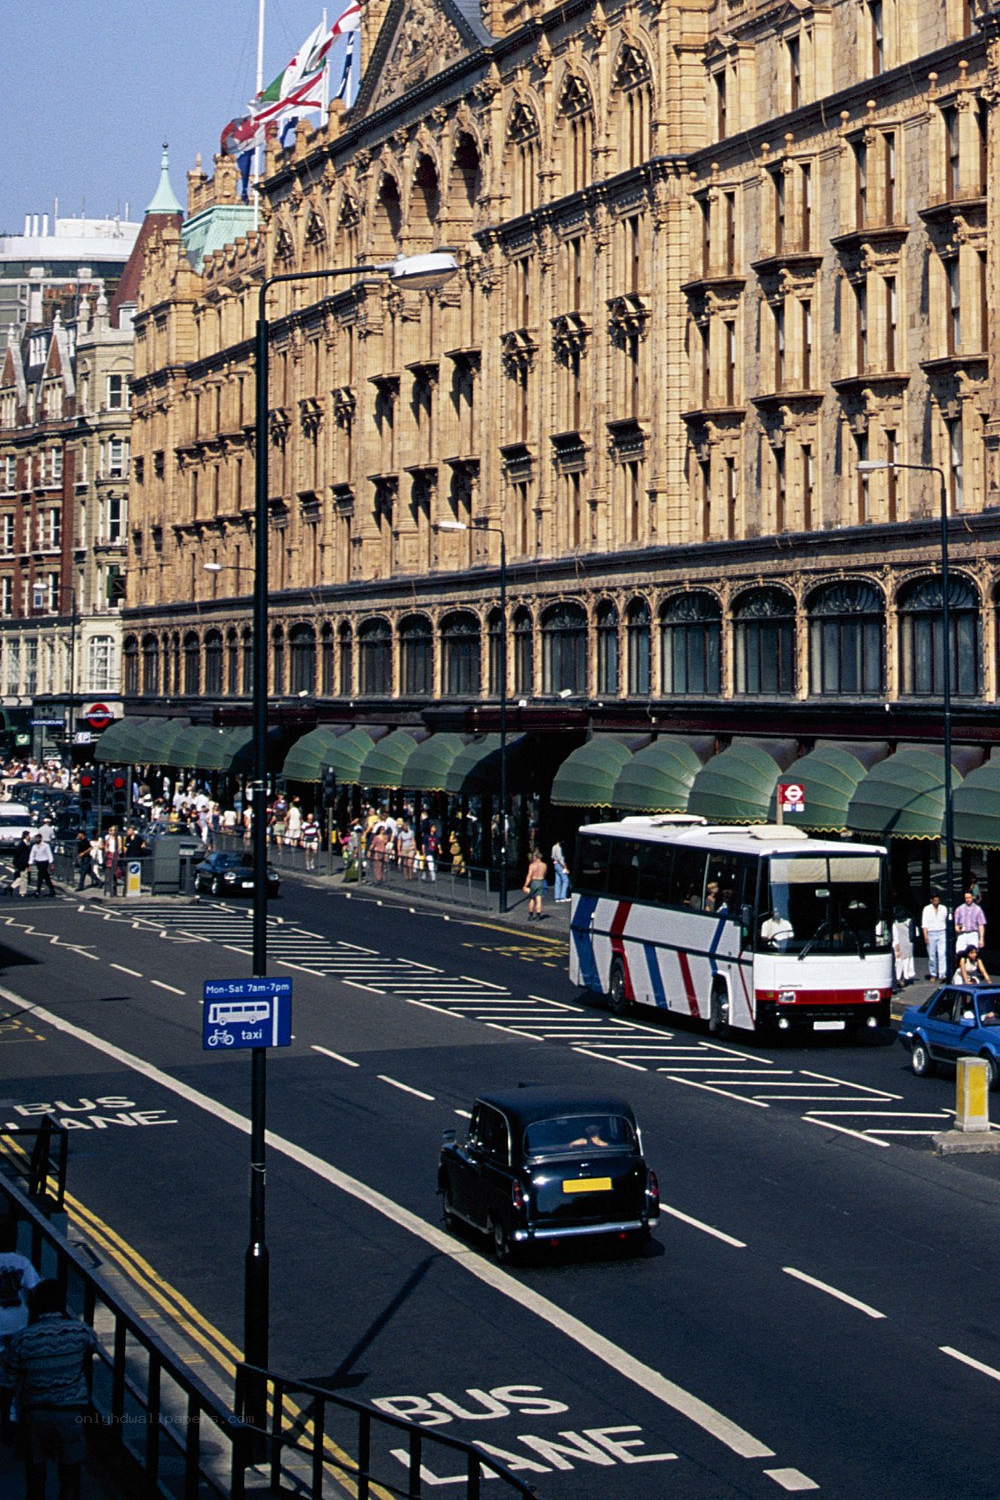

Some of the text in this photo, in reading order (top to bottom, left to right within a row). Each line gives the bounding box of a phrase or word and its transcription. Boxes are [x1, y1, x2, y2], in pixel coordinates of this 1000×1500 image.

[206, 983, 290, 994] Mon-Sat 7am-7pm
[241, 1029, 262, 1040] taxi
[13, 1096, 136, 1116] BUS
[4, 1110, 178, 1130] ANE
[370, 1385, 569, 1426] BUS
[389, 1425, 679, 1485] LANE
